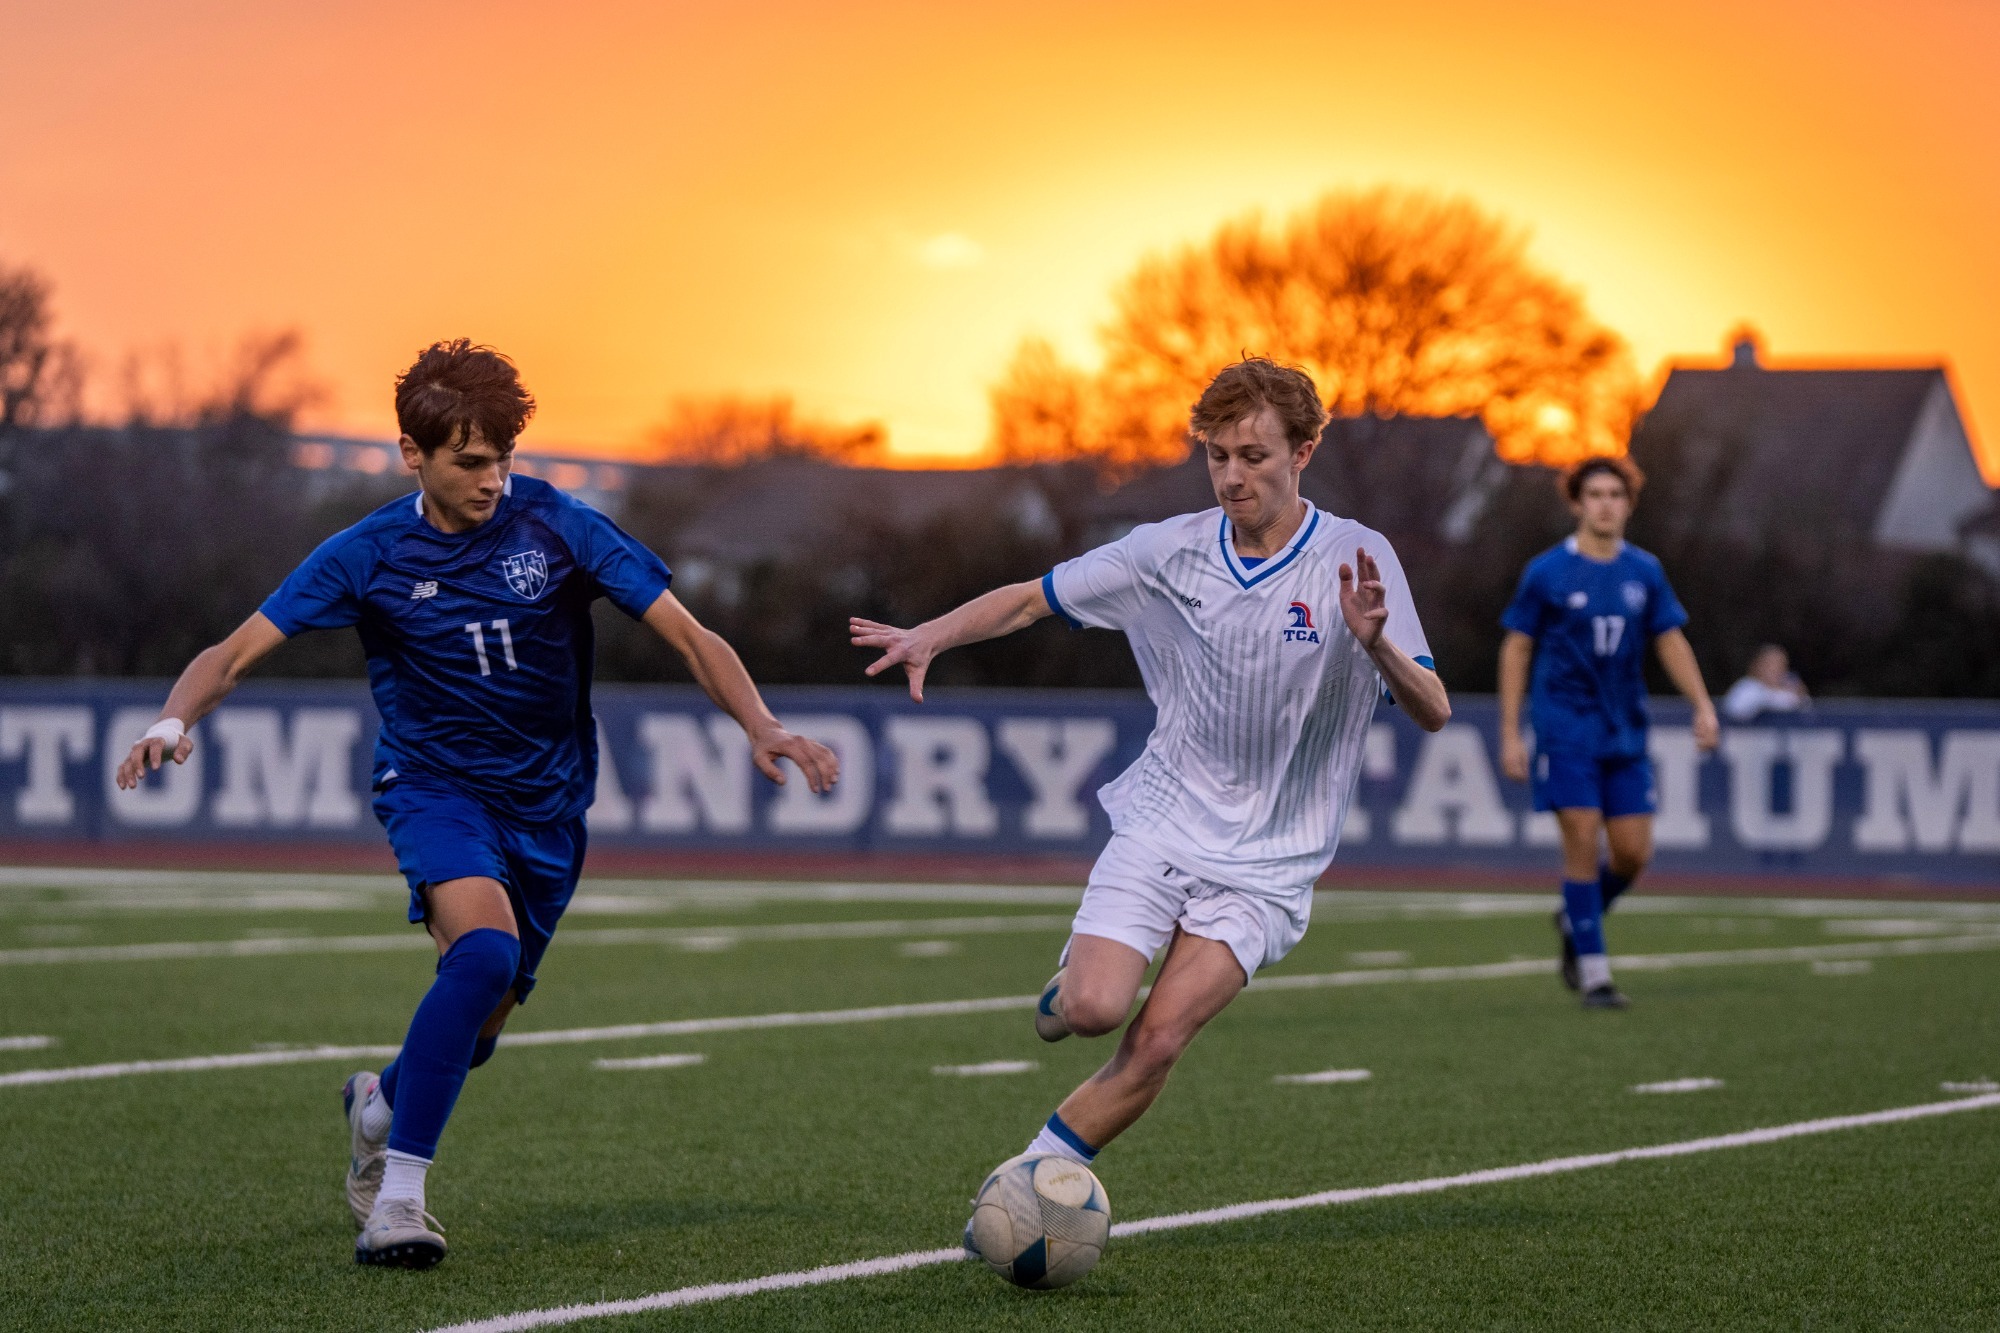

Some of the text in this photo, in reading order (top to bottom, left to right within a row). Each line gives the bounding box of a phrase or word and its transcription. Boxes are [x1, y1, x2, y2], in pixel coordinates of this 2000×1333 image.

[464, 618, 517, 676] 11
[1283, 629, 1320, 644] TCA
[1592, 614, 1626, 657] 17
[0, 706, 361, 827] TOM
[1341, 722, 2000, 852] AIUM
